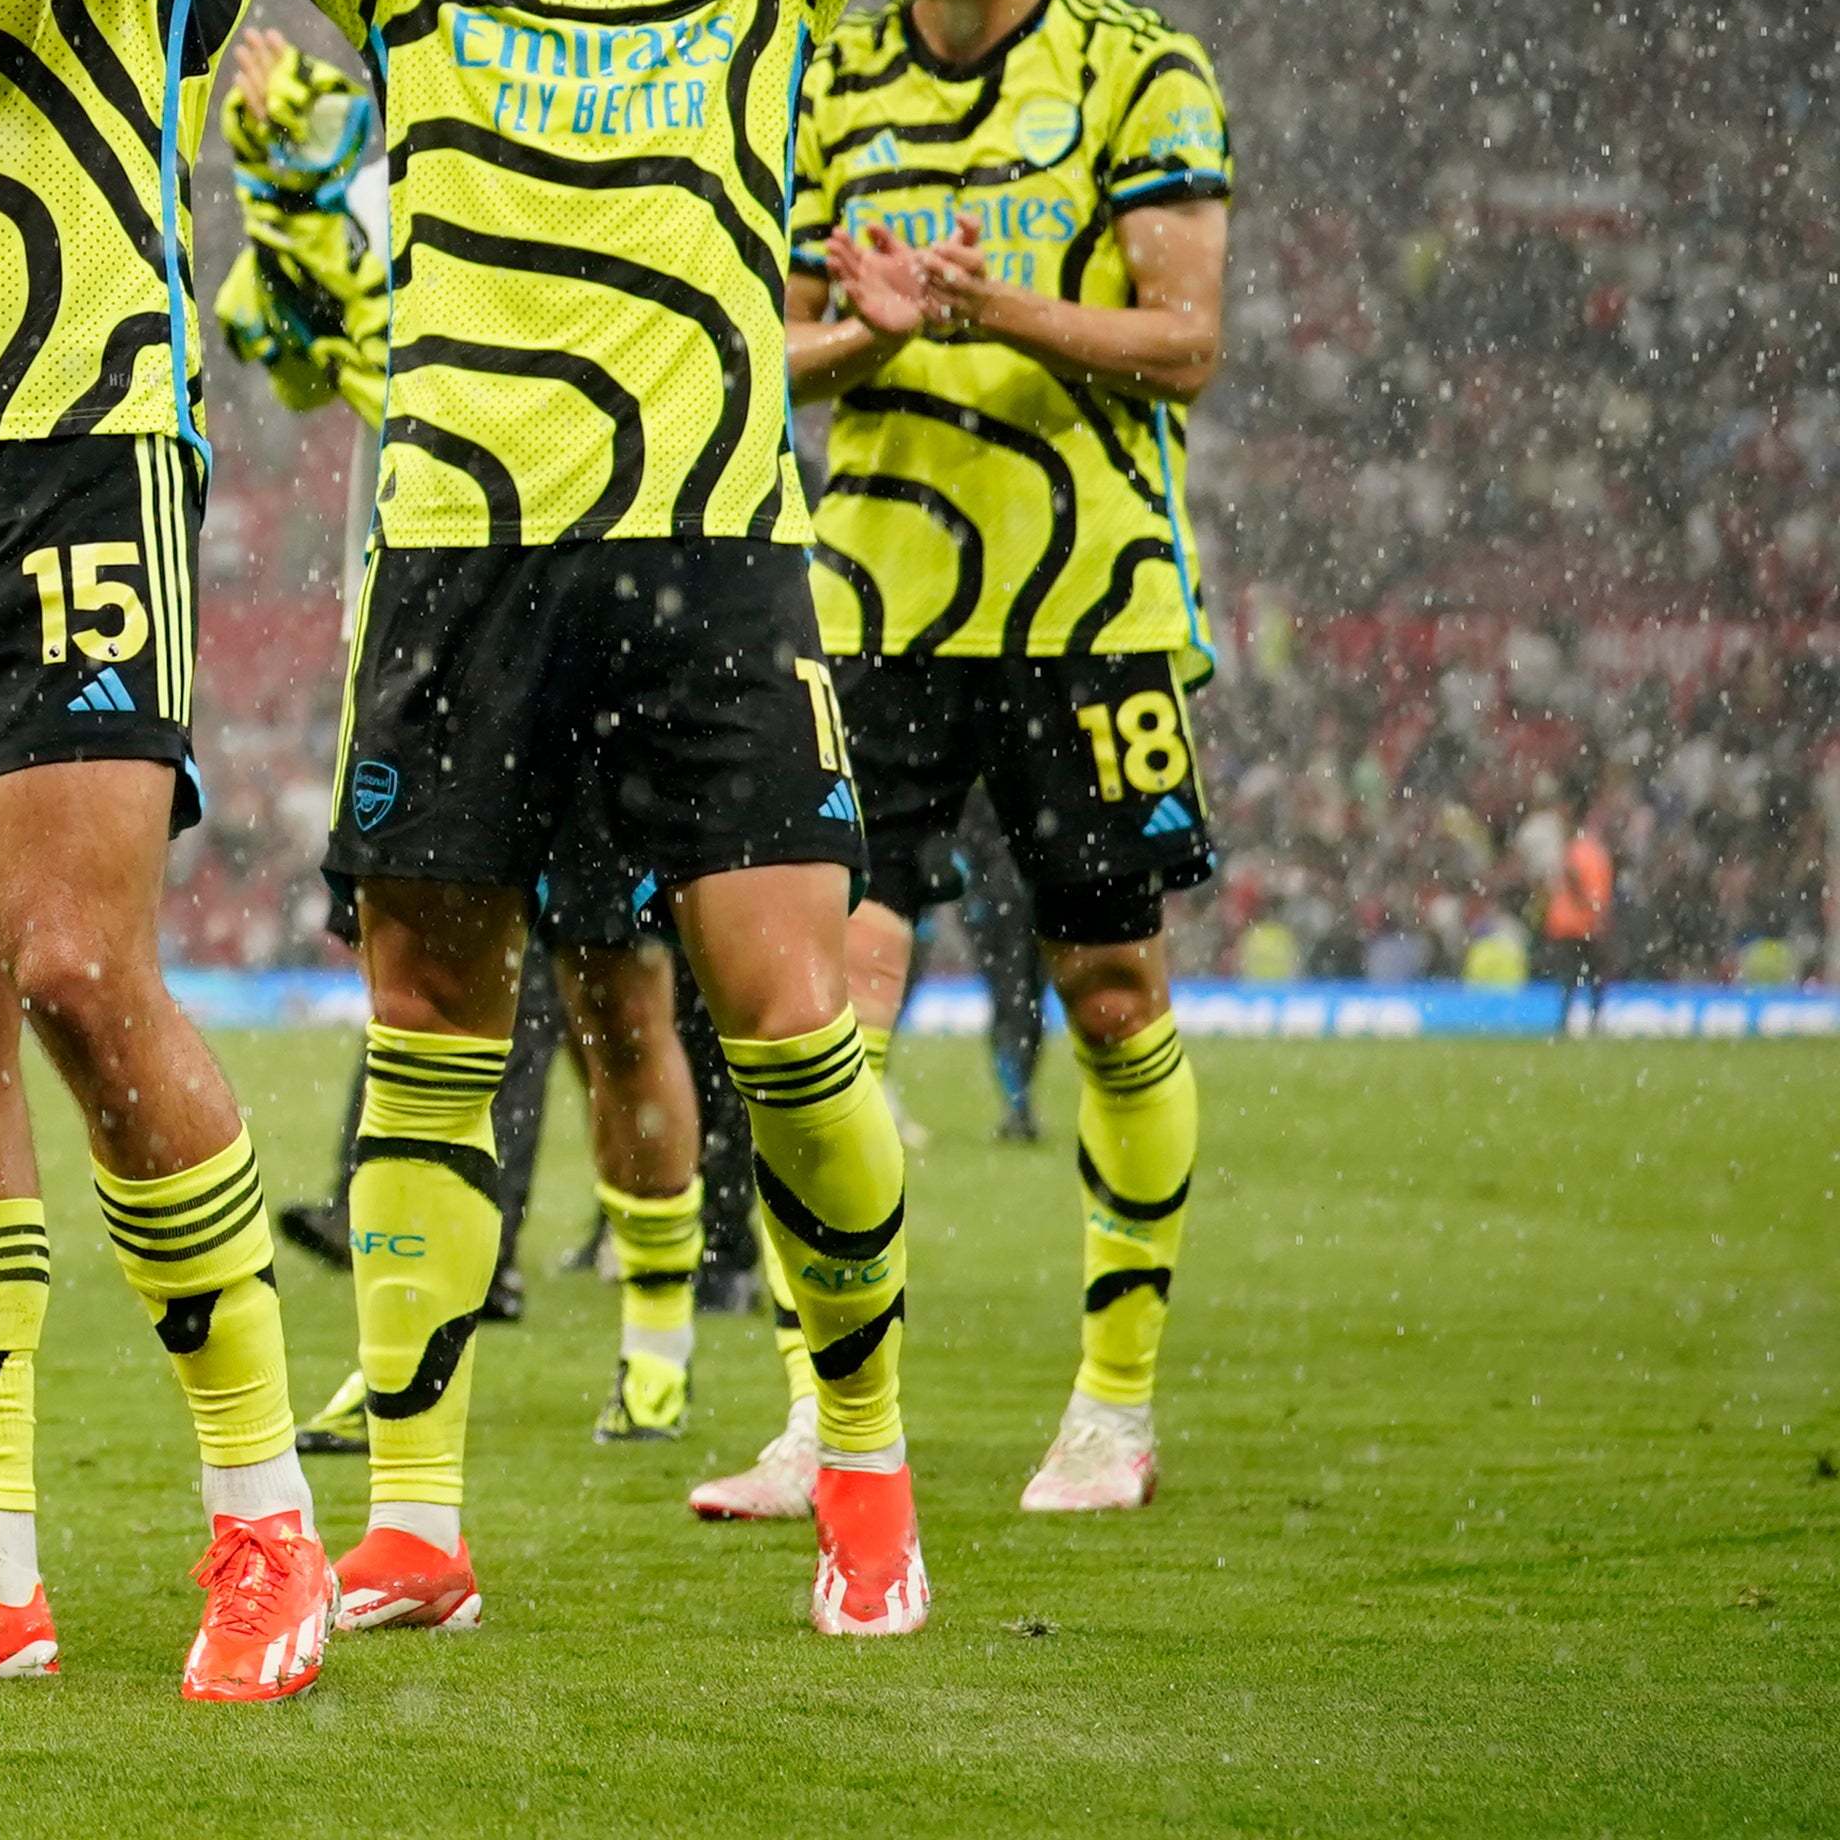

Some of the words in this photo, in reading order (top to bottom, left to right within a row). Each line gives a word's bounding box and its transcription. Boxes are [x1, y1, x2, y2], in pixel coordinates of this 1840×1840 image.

[494, 81, 558, 134] FLY
[22, 542, 149, 665] 15
[1077, 690, 1189, 803] 18
[349, 1229, 426, 1257] AFC
